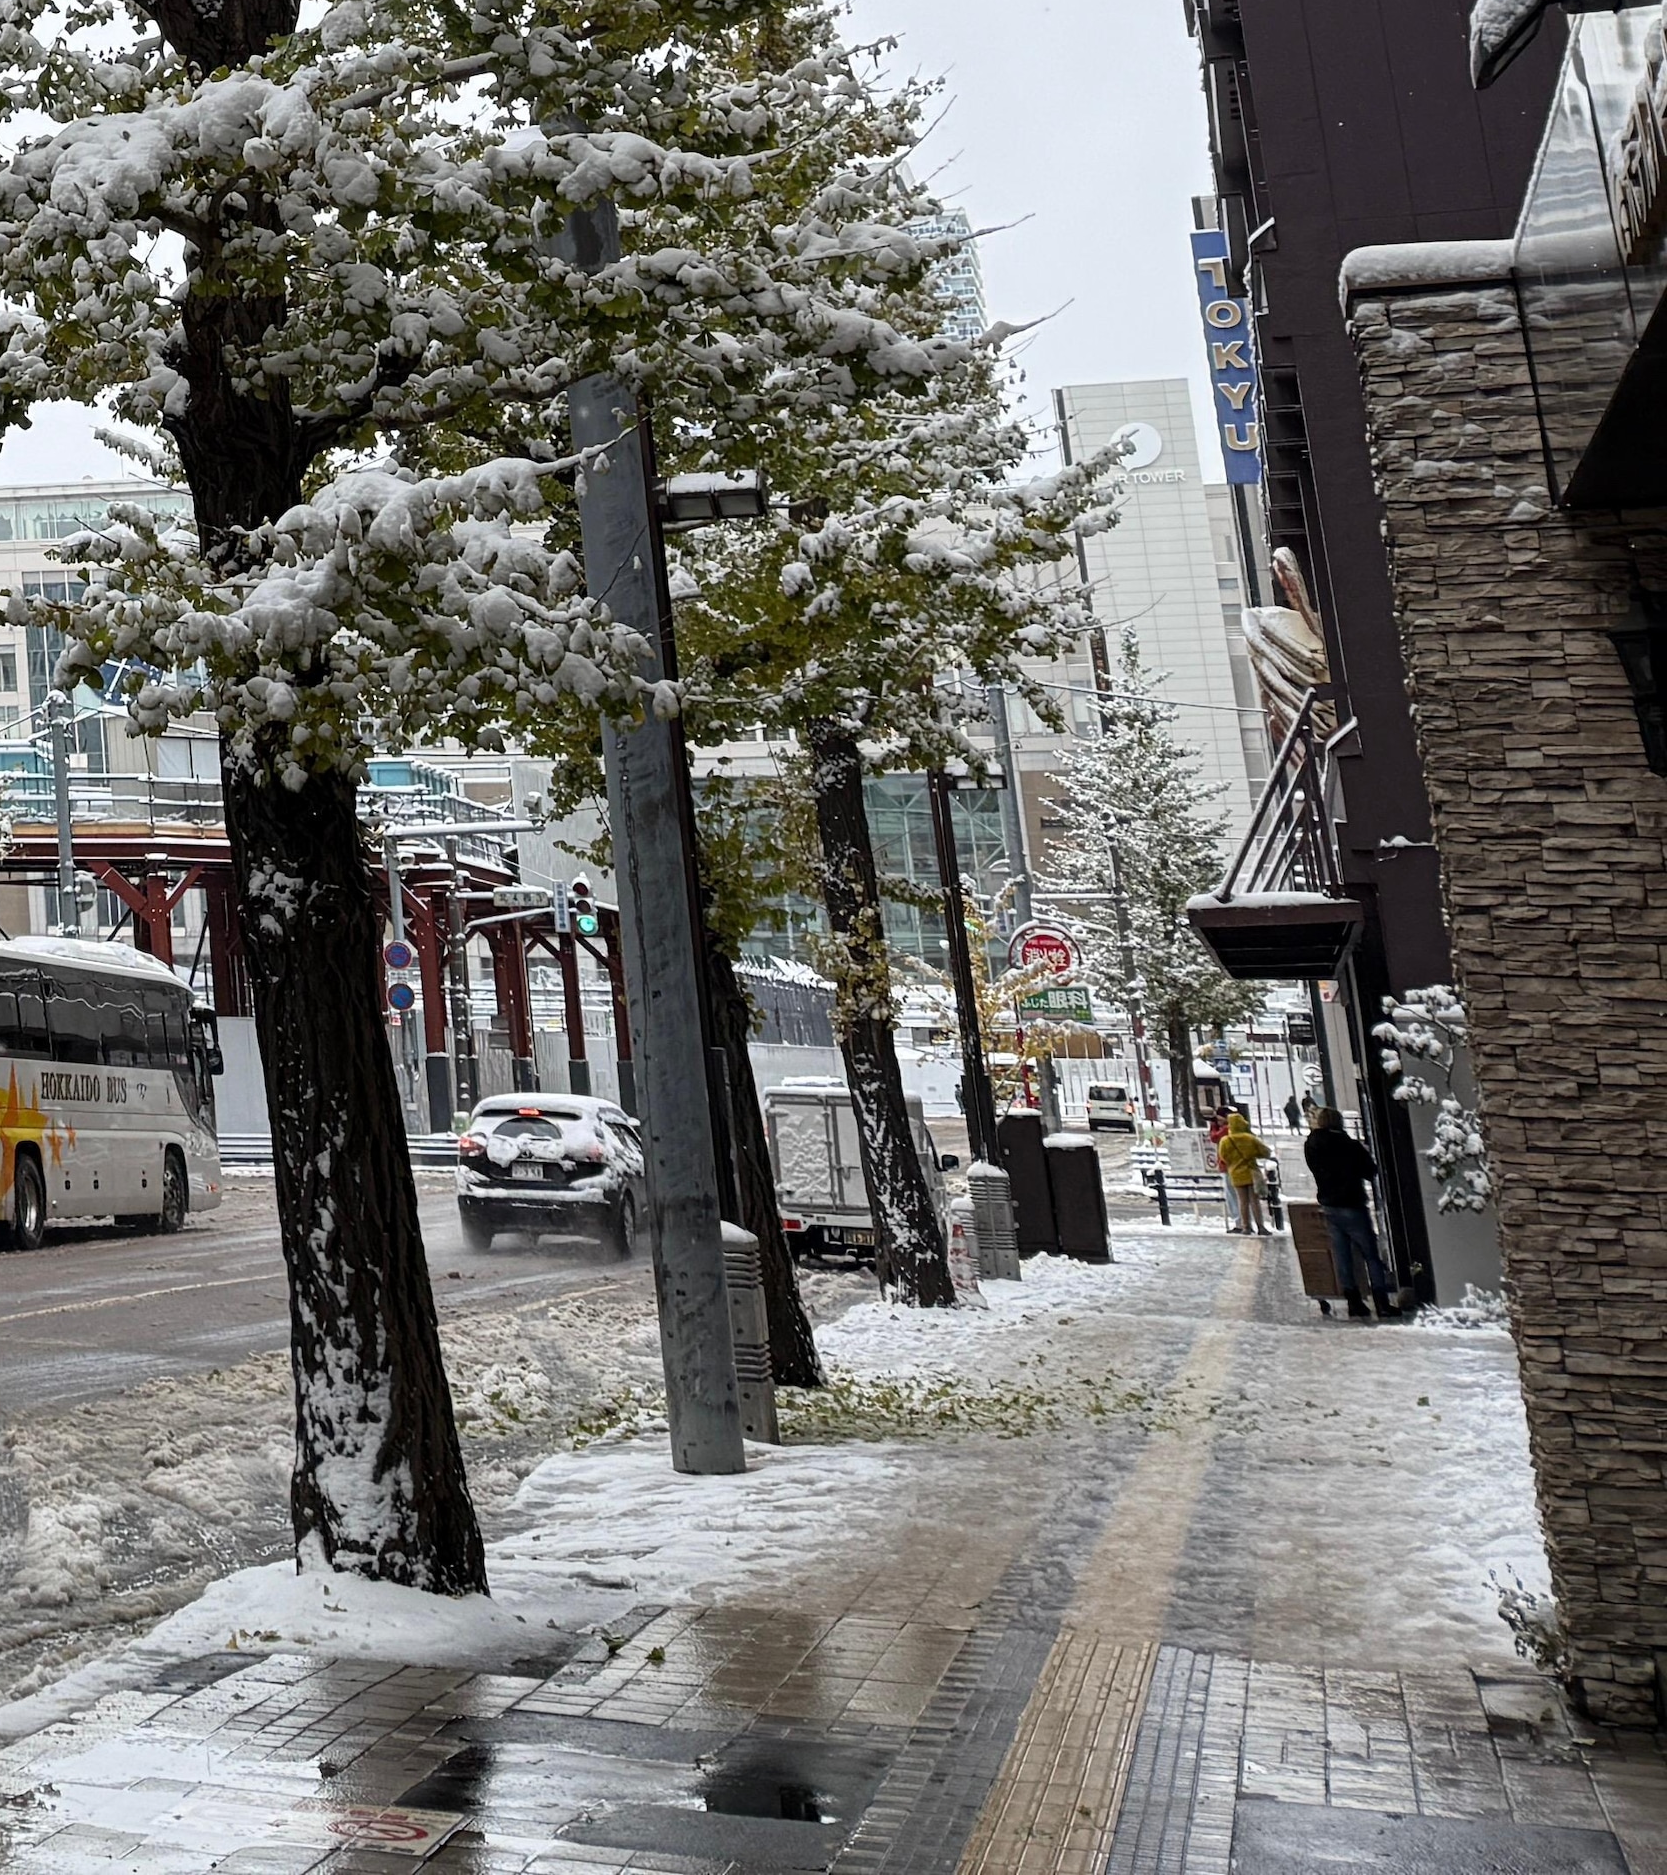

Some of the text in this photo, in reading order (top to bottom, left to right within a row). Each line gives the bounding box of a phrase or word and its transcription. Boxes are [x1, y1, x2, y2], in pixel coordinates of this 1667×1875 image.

[1197, 256, 1259, 452] TOKYU
[1129, 469, 1187, 484] TOWER
[40, 1071, 127, 1104] HOKKAIDO BUS
